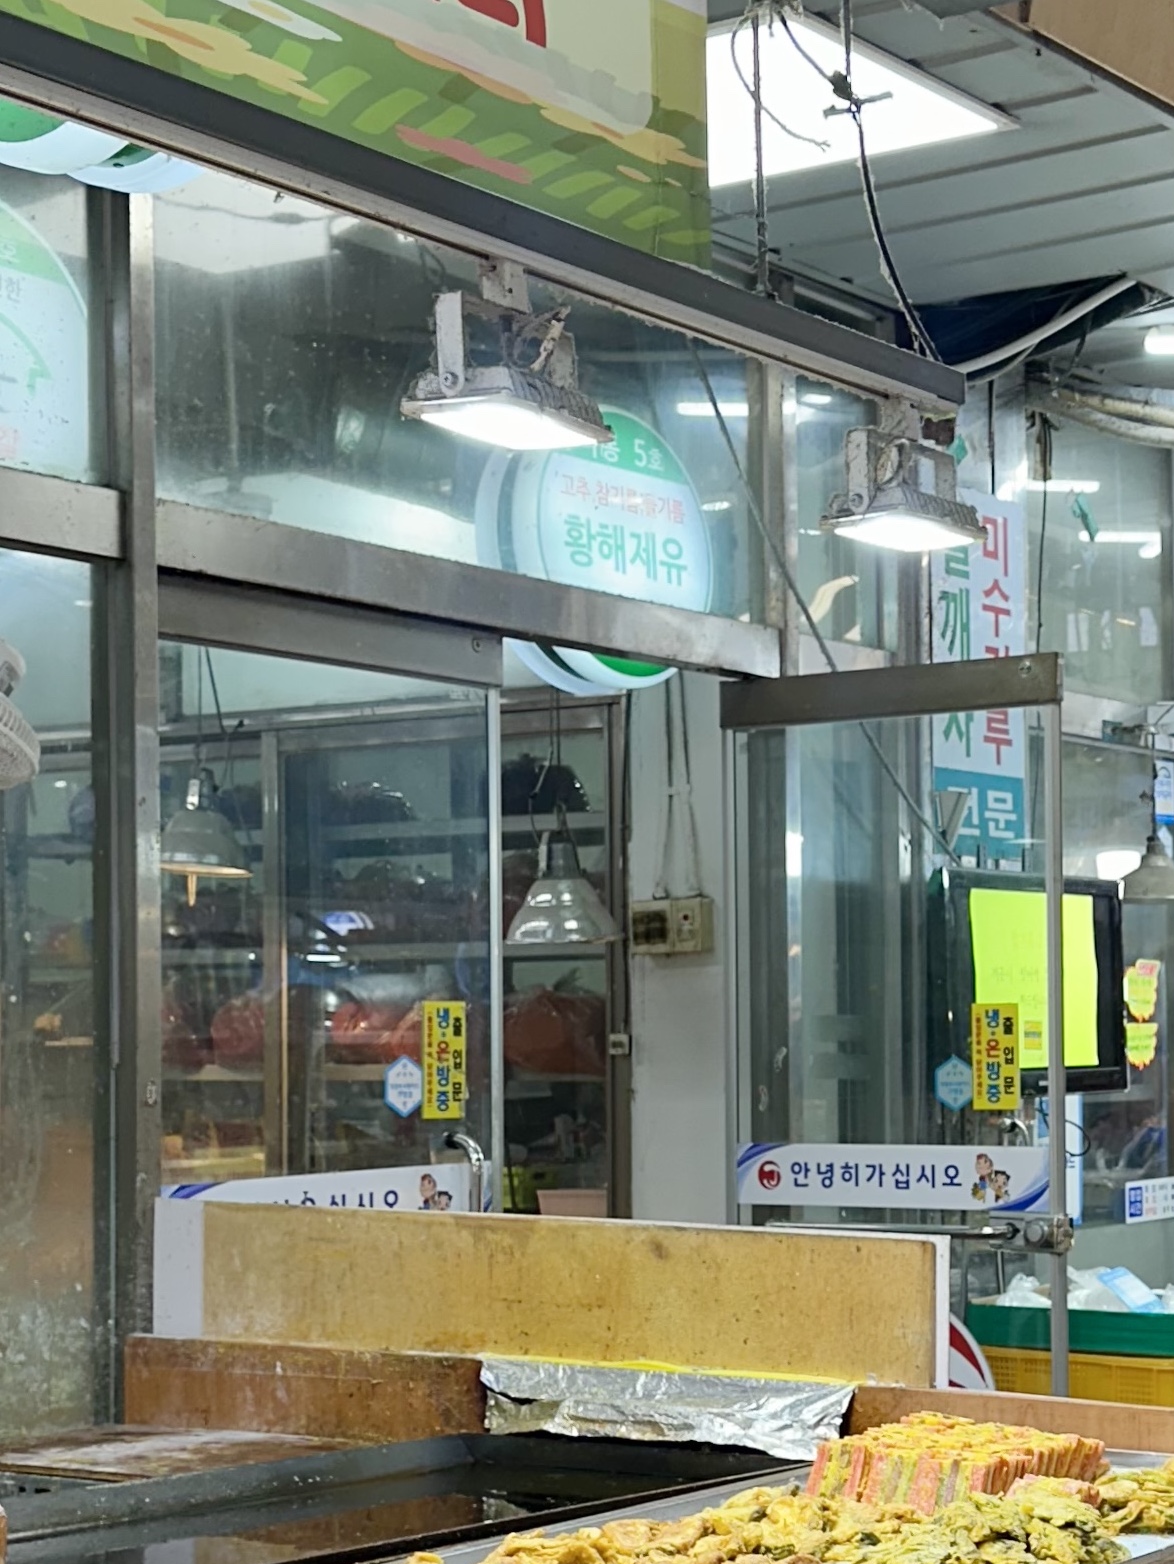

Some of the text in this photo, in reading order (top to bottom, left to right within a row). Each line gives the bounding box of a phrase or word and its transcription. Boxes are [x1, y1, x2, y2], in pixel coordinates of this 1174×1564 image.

[633, 438, 665, 473] 5호
[563, 513, 688, 587] 황해제유
[981, 516, 1014, 766] 미수루
[790, 1160, 964, 1190] 안녕히가십시오
